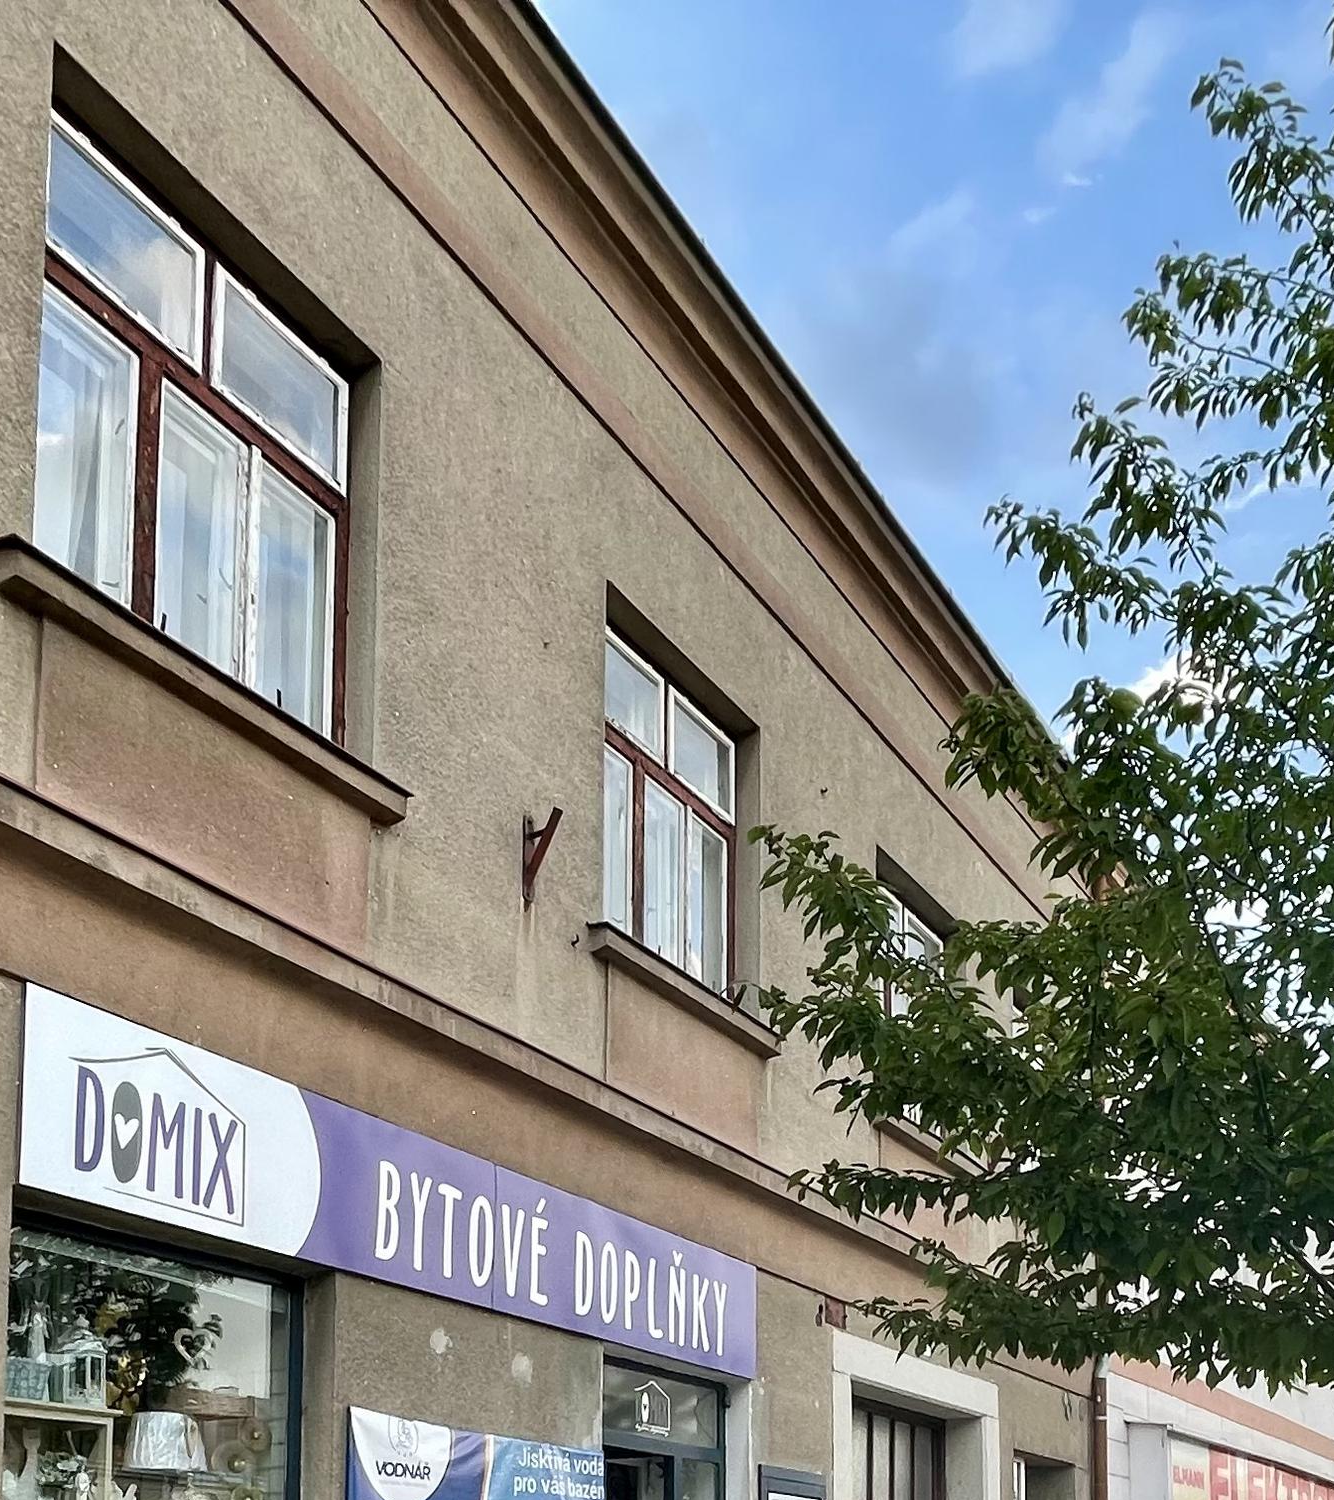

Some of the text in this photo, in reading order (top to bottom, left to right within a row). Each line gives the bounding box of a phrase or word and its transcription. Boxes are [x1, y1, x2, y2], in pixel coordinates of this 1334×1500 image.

[75, 1065, 237, 1215] DOMIX
[373, 1160, 728, 1356] BYTOVÉ DOPLŇKY
[375, 1460, 431, 1481] VODNÁŘ
[574, 1456, 604, 1476] voda
[514, 1474, 604, 1500] pro váš bazén
